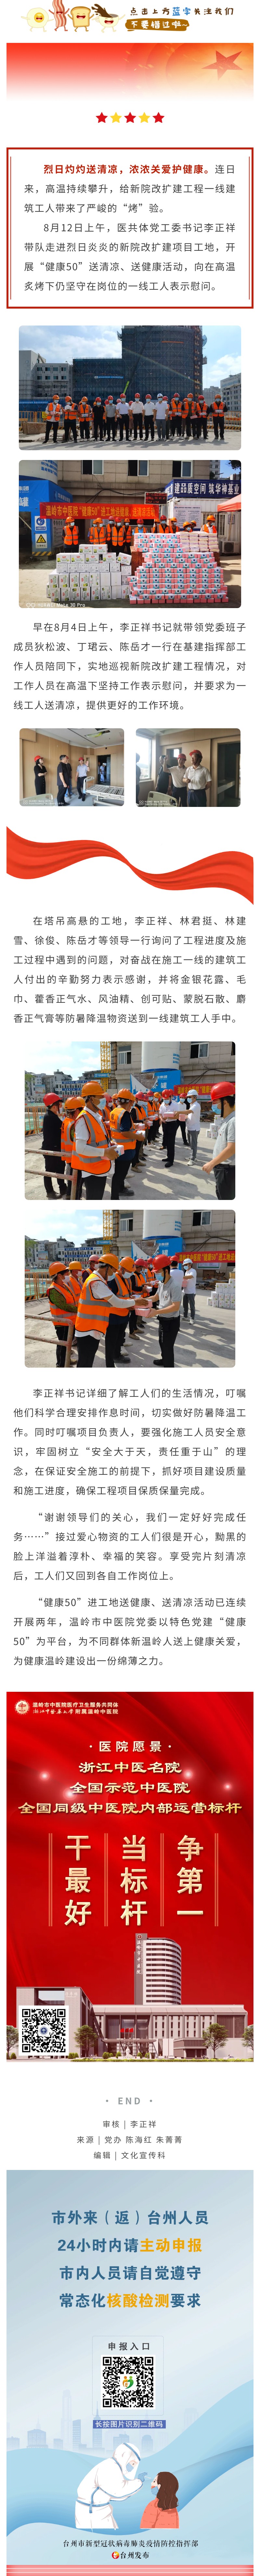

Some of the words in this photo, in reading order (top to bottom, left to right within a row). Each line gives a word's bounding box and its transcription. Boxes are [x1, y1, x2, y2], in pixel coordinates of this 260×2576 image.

[131, 6, 233, 16] 点击上方蓝字关注我们
[44, 164, 234, 174] 烈日灼灼送清凉，浓浓关爱护健康。连日
[24, 184, 235, 193] 来，高温持续攀升，给新院改扩建工程一线建
[24, 204, 163, 213] 筑工人带来了严峻的“烤”验。
[44, 223, 235, 232] 8月12日上午，医共体党工委书记李正祥
[24, 243, 235, 252] 带队走进烈日炎炎的新院改扩建项目工地，开
[24, 262, 235, 271] 展“健康50”送清凉、送健康活动，向在高温
[25, 282, 215, 291] 炙烤下仍坚守在岗位的一线工人表示慰问。
[175, 483, 206, 494] 建品质空间
[209, 483, 240, 495] 筑华神基业
[33, 623, 246, 632] 早在8月4日上午，李正祥书记就带领党委班子
[14, 642, 246, 651] 成员狄松波、丁珺云、陈岳才一行在基建指挥部工
[14, 662, 246, 671] 作人员陪同下，实地巡视新院改扩建工程情况，对
[14, 681, 246, 690] 工作人员在高温下坚持工作表示慰问，并要求为一
[14, 701, 183, 710] 线工人送清凉，提供更好的工作环境。
[33, 916, 246, 925] 在塔吊高悬的工地，李正祥、林君挺、林建
[14, 936, 246, 945] 雪、徐俊、陈岳才等领导一行询问了工程进度及施
[14, 955, 246, 964] 工过程中遇到的问题，对奋战在施工一线的建筑工
[14, 975, 246, 984] 人付出的辛勤努力表示感谢，并将金银花露、毛
[14, 994, 246, 1003] 巾、藿香正气水、风油精、创可贴、蒙脱石散、麝
[14, 1014, 235, 1023] 香正气膏等防暑降温物资送到一线建筑工人手中。
[179, 1253, 235, 1262] 温岭市中医院“健康50”进工地送
[33, 1389, 245, 1398] 李正祥书记详细了解工人们的生活情况，叮嘱
[14, 1408, 246, 1417] 他们科学合理安排作息时间，切实做好防暑降温工
[14, 1428, 245, 1437] 作。同时叮嘱项目负责人，要强化施工人员安全意
[14, 1447, 246, 1456] 识，牢固树立“安全大于天，责任重于山”的理
[14, 1466, 246, 1476] 念，在保证安全施工的前提下，抓好项目建设质量
[14, 1486, 204, 1495] 和施工进度，确保工程项目保质保量完成。
[39, 1513, 246, 1522] “谢谢领导们的关心，我们一定好好完成任
[14, 1552, 245, 1561] 脸上洋溢着淳朴、幸福的笑容。享受完片刻清凉
[14, 1571, 173, 1580] 后，工人们又回到各自工作岗位上。
[39, 1598, 245, 1607] “健康50”进工地送健康、送清凉活动已连续
[14, 1617, 246, 1626] 开展两年，温岭市中医院党委以特色党建“健康
[14, 1637, 240, 1646] 50”为平台，为不同群体新温岭人送上健康关爱，
[14, 1656, 162, 1665] 为健康温岭建设出一份绵薄之力。
[79, 1762, 182, 1773] 浙江中医名院
[70, 1782, 190, 1794] 全国示范中医院
[18, 1803, 242, 1814] 全国同级中医院内部运营标杆
[58, 2238, 202, 2252] 24小时内请主动申报
[60, 2266, 201, 2280] 市内人员请自觉遵守
[60, 2293, 201, 2308] 常态化核酸检测要求
[109, 2342, 149, 2351] 申报入口
